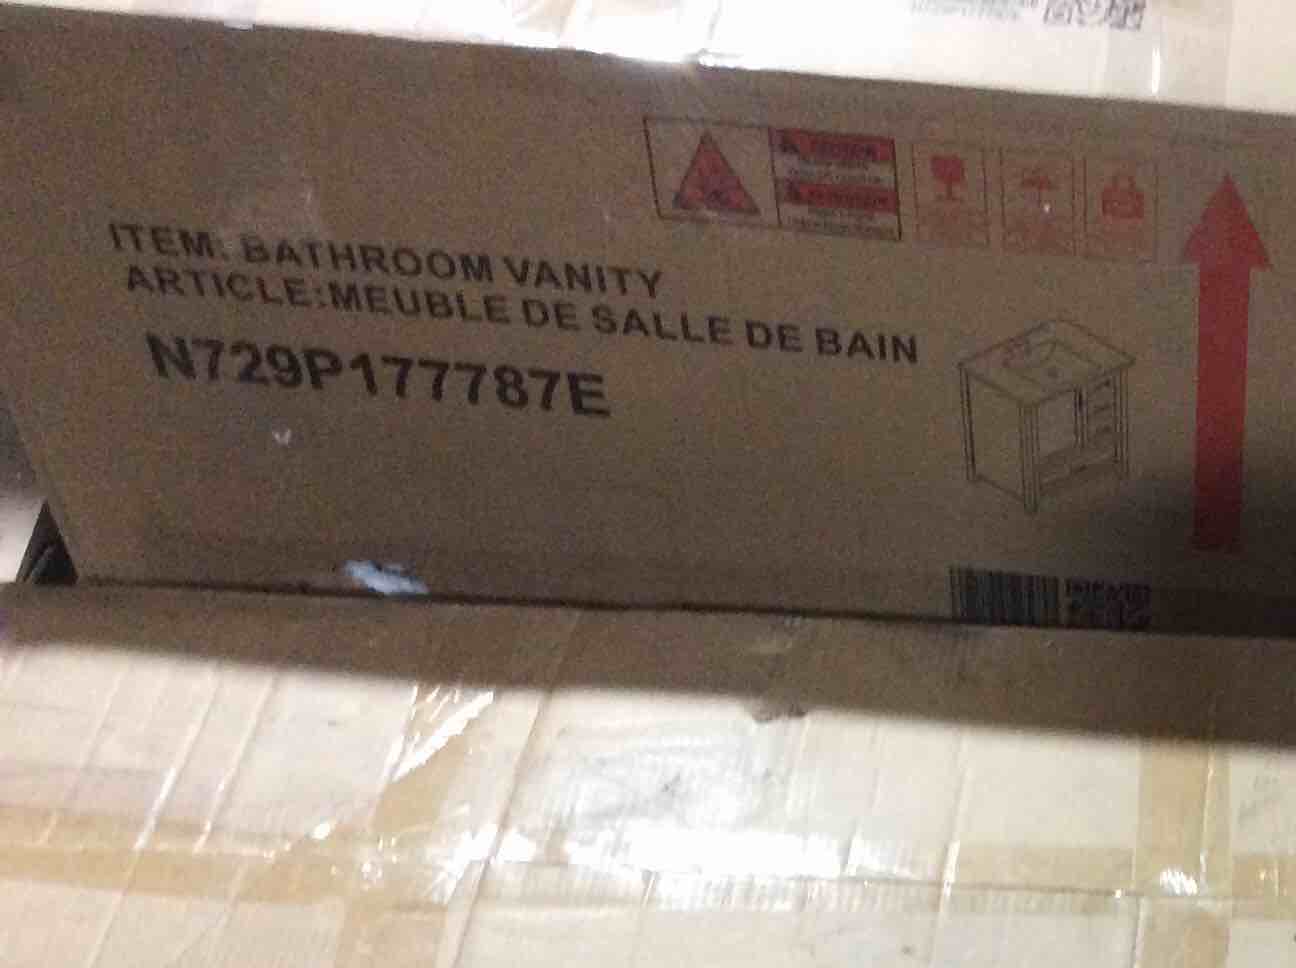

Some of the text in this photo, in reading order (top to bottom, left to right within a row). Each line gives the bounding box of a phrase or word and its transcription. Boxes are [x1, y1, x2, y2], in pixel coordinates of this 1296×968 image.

[240, 234, 494, 283] BATHROOM
[503, 256, 663, 299] VANITY
[522, 298, 582, 332] DE
[592, 305, 735, 346] SALLE
[745, 320, 804, 354] DE
[815, 326, 922, 364] BAIN
[145, 331, 611, 418] N729P177787E
